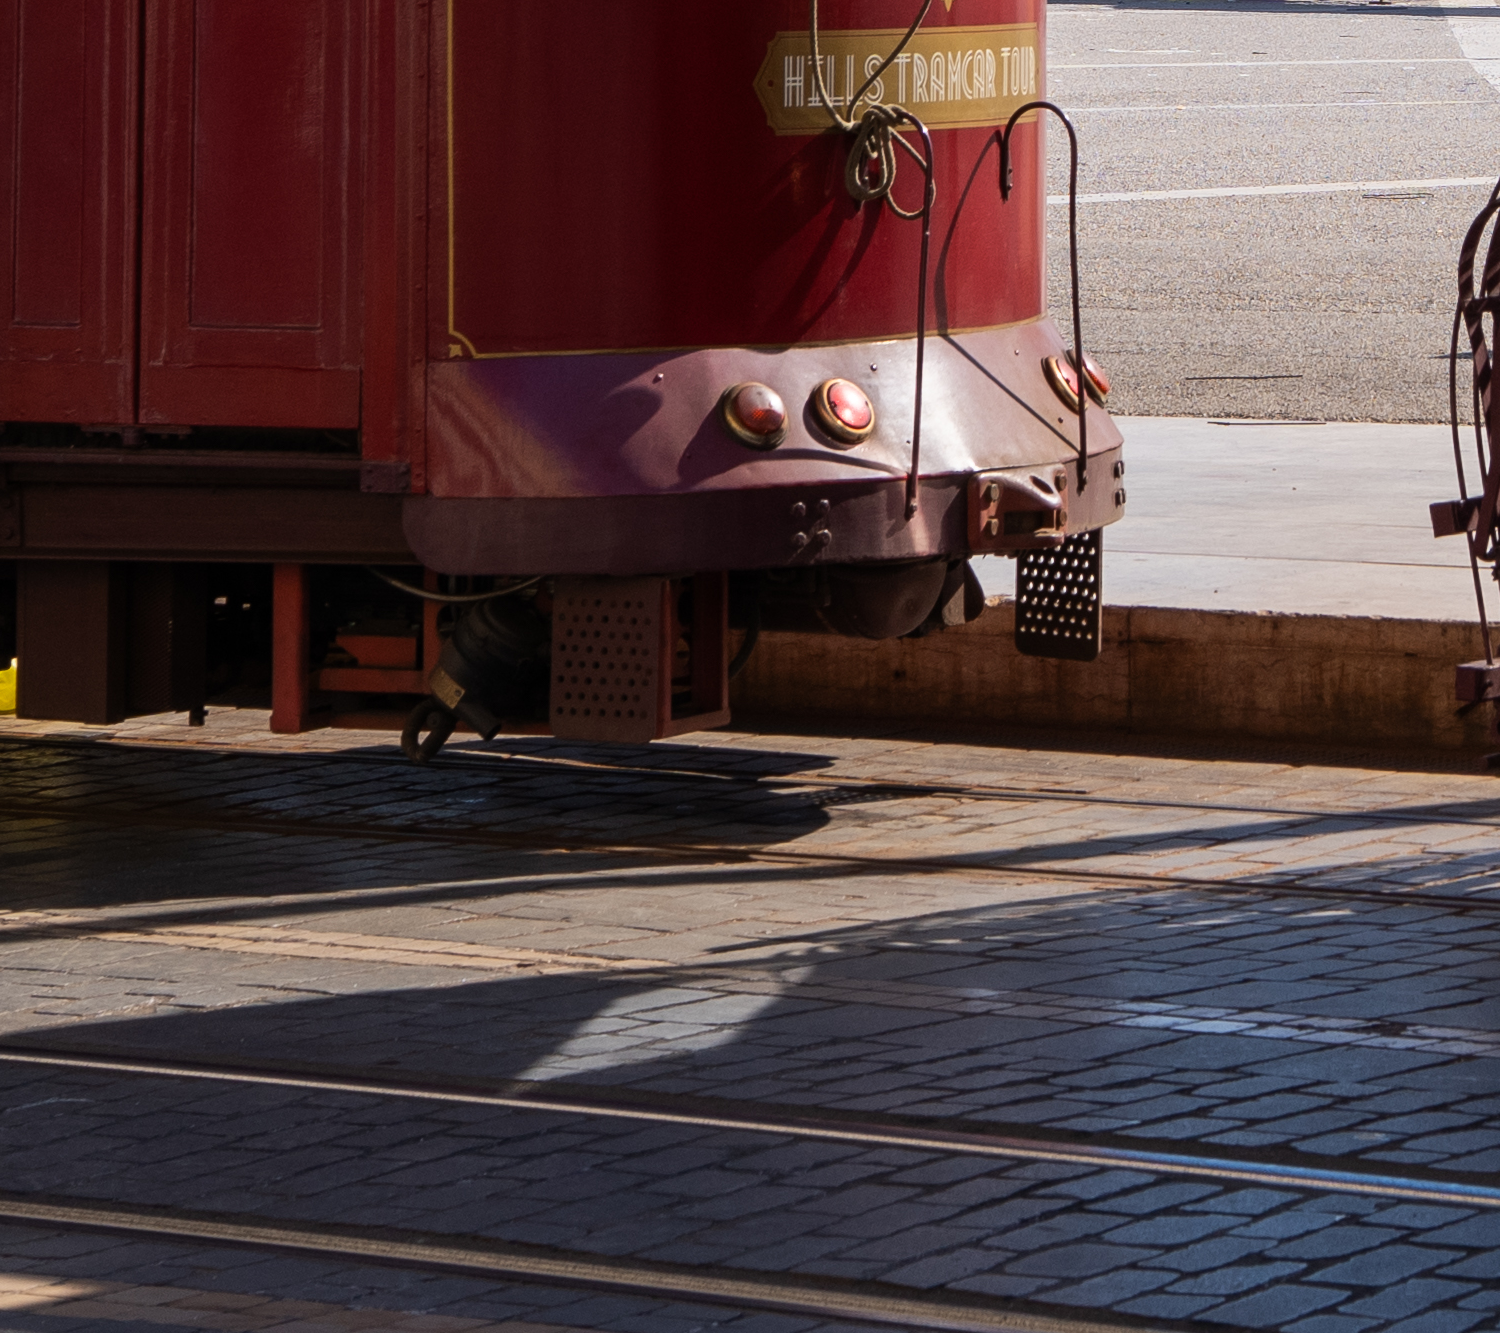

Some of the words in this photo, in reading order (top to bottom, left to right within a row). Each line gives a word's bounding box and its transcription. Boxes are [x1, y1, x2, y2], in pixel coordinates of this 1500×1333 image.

[784, 54, 885, 107] HILLS
[894, 48, 997, 104] TRAMCAR
[1001, 46, 1036, 96] TOUR
